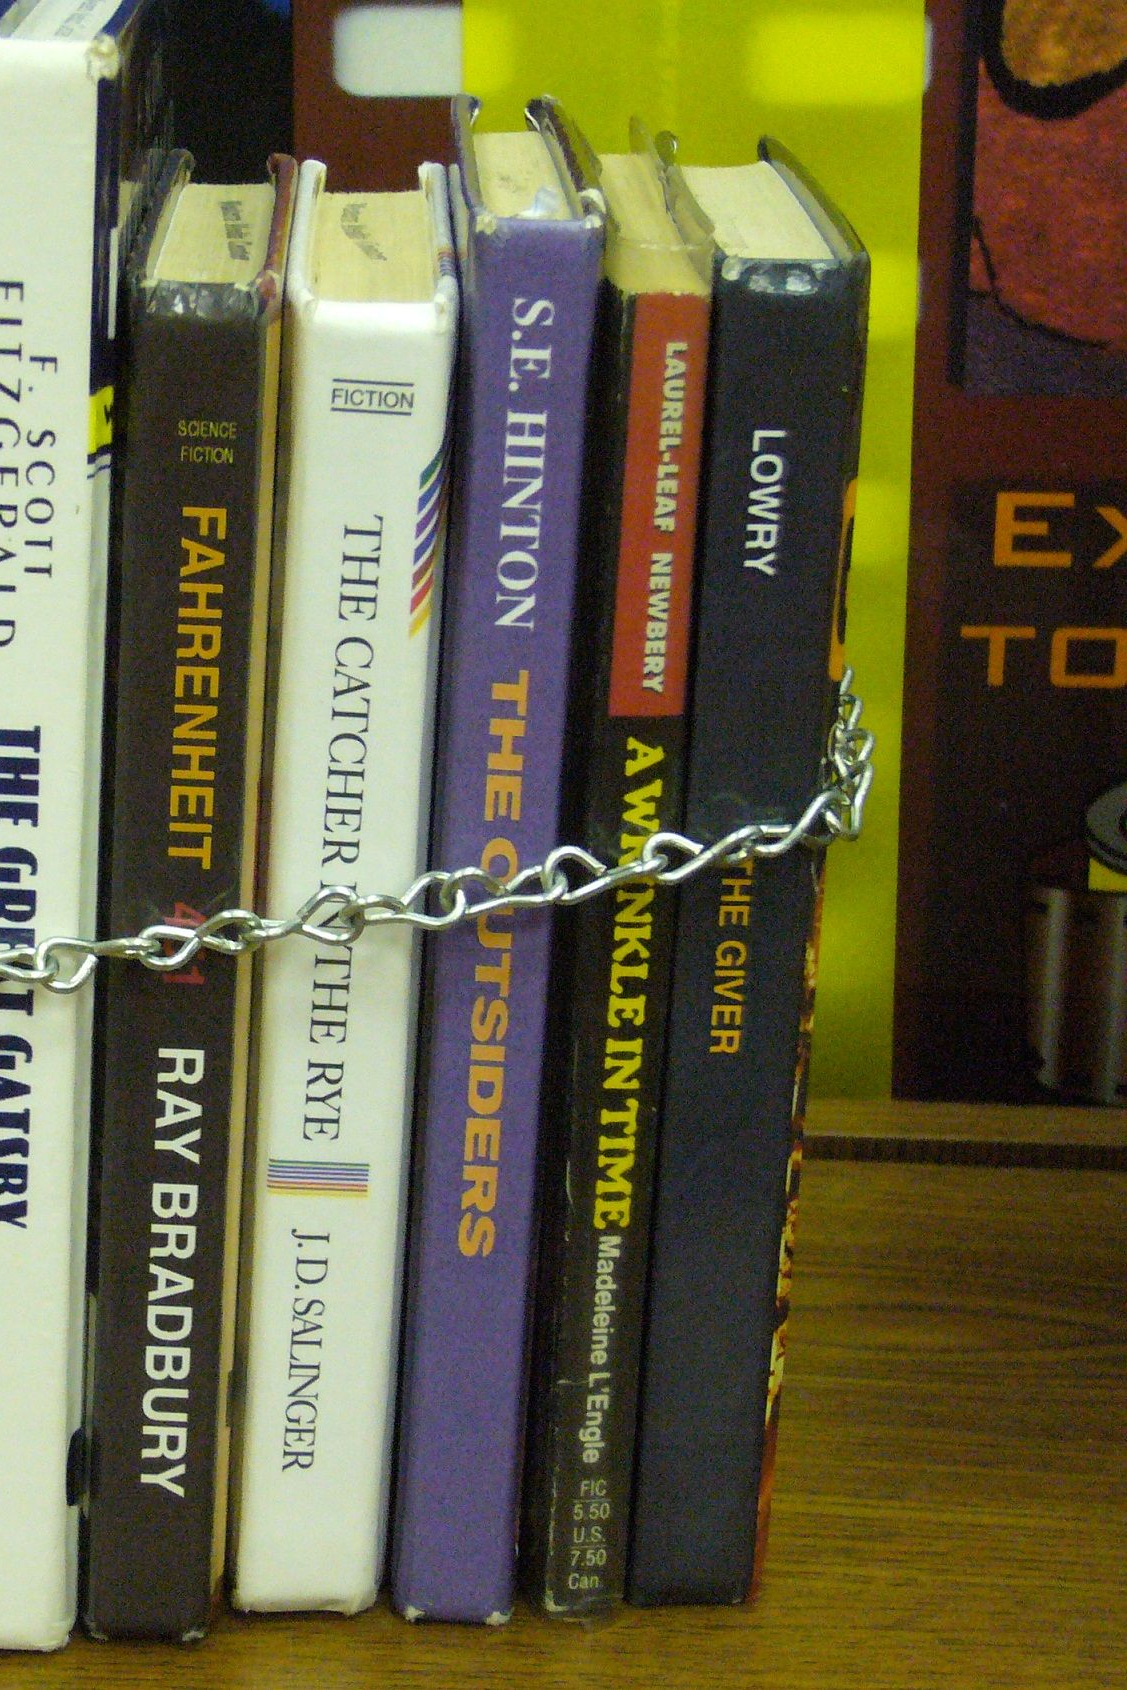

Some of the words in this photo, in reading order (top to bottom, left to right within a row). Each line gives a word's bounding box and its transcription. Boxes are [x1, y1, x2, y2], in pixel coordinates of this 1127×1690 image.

[28, 356, 58, 391] F.
[177, 420, 237, 440] SCIENCE
[332, 387, 415, 409] FICTION
[180, 447, 234, 464] FICTION
[653, 341, 688, 532] LAUREL-LEAF
[24, 429, 56, 578] SCOTT
[494, 410, 547, 632] HINTON
[743, 429, 788, 577] LOWRY
[336, 515, 382, 621] THE
[642, 552, 673, 692] NEWBERY
[168, 507, 228, 869] FAHRENHEIT
[484, 671, 528, 821] THE
[321, 634, 374, 867] CATCHER
[626, 737, 664, 775] A
[163, 901, 207, 985] 41
[308, 946, 352, 1043] THE
[710, 940, 750, 1056] GIVER
[303, 1059, 343, 1141] RYE
[458, 837, 516, 1257] OUTSIDERS
[603, 1039, 644, 1089] IN
[152, 1048, 206, 1164] RAY
[594, 1099, 642, 1229] TIME
[140, 1184, 199, 1498] BRADBURY
[591, 1236, 620, 1366] Madeleine
[282, 1298, 325, 1472] SALINGER
[579, 1371, 611, 1464] L'Engle
[580, 1480, 607, 1497] FIC
[570, 1549, 607, 1567] 7.50
